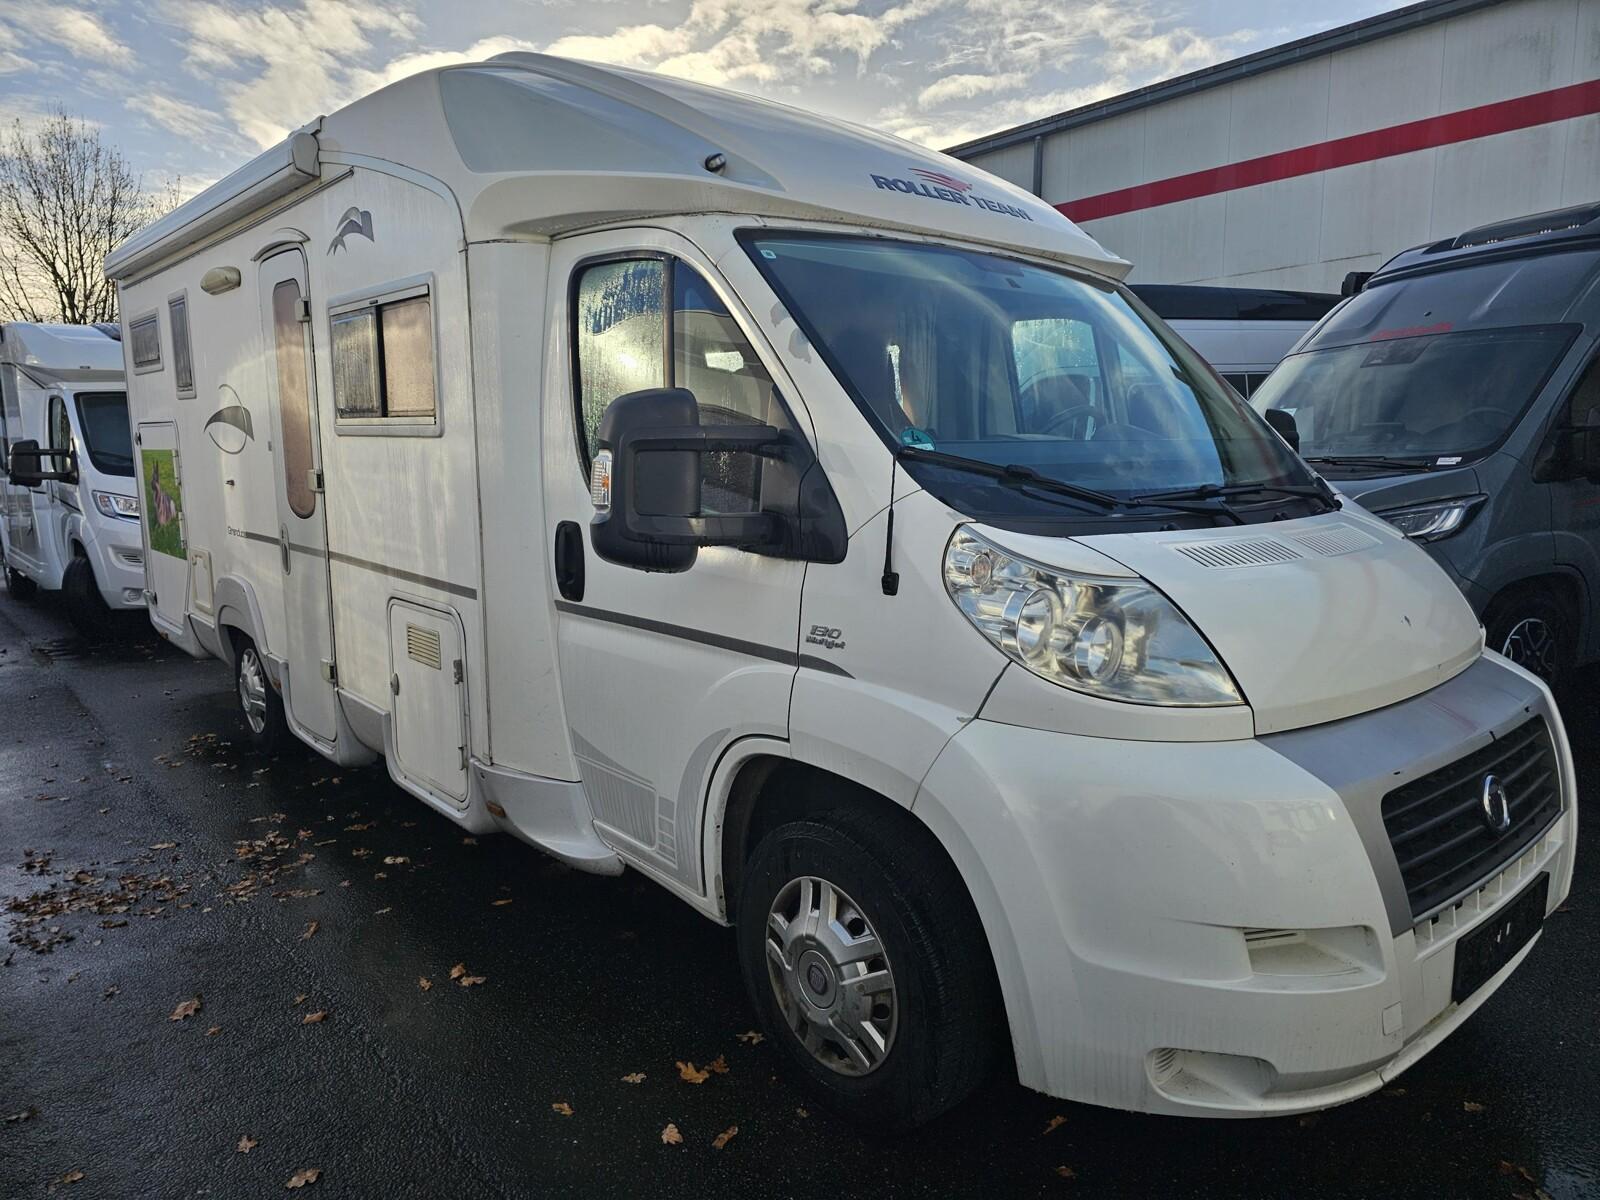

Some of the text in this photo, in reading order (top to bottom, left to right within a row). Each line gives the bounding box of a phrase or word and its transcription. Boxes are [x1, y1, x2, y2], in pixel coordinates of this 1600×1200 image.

[869, 174, 1034, 221] ROLLER TEAM
[910, 430, 922, 443] 4
[810, 625, 842, 640] 130
